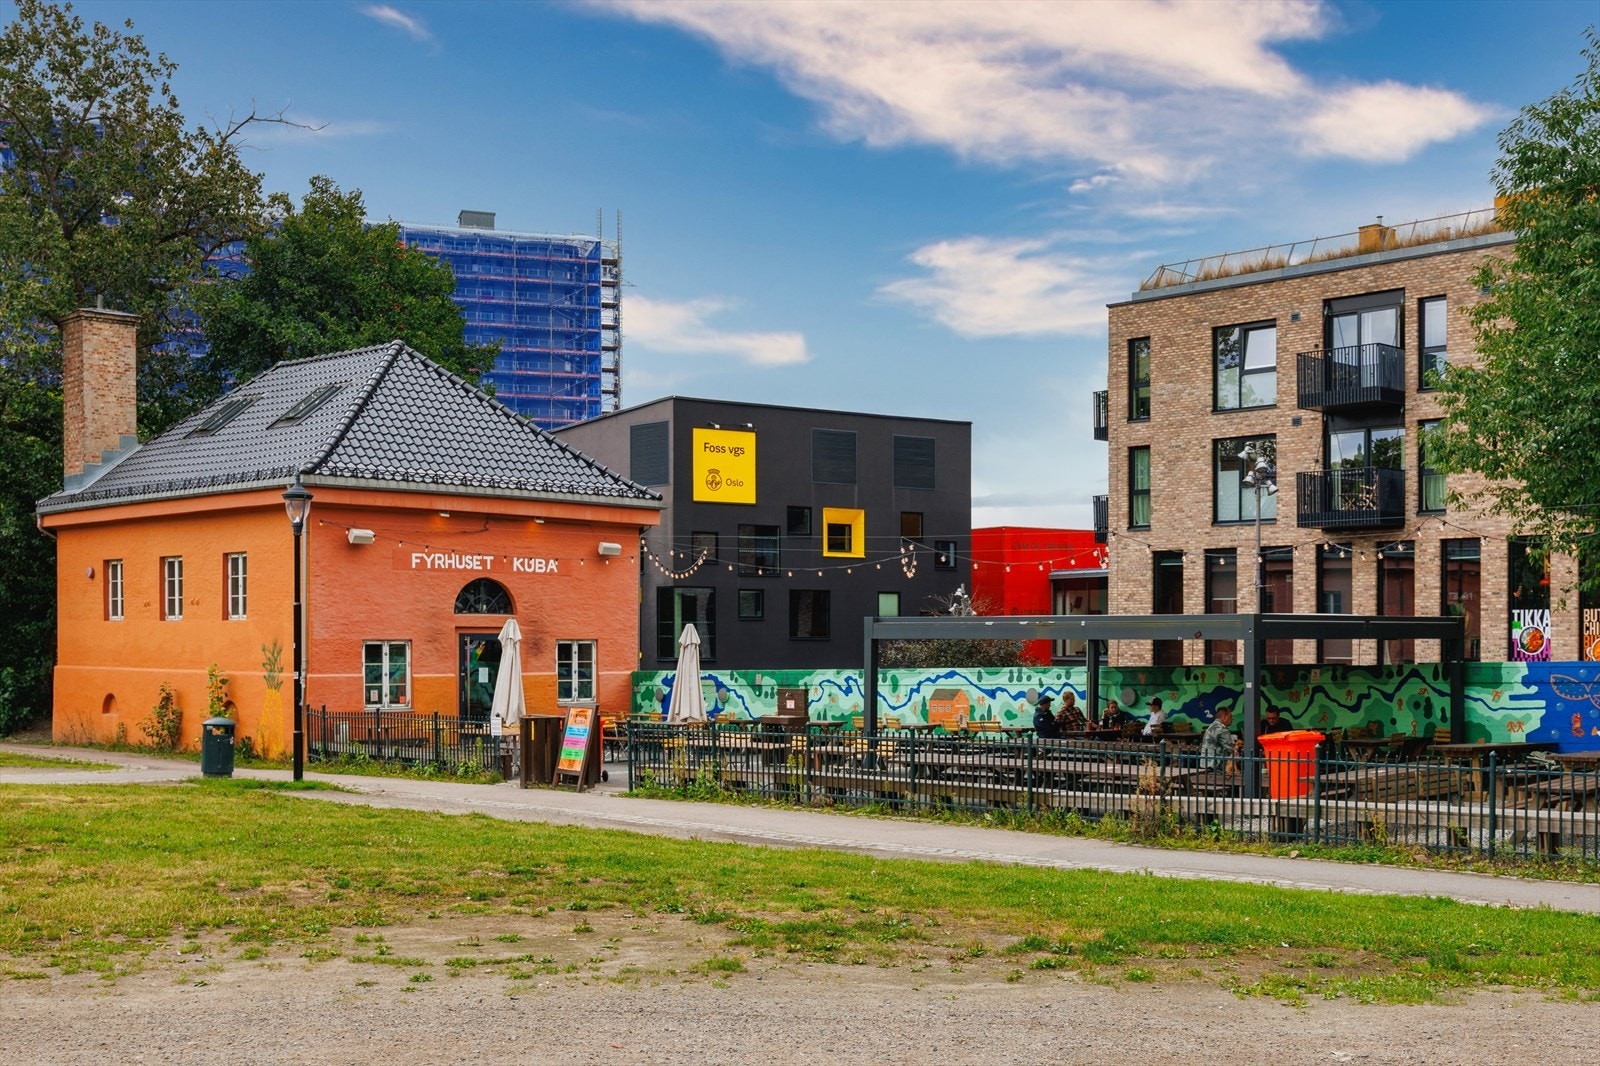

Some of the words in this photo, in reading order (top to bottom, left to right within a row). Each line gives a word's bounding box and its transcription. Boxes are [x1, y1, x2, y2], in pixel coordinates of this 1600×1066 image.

[703, 442, 726, 454] Foss
[728, 446, 745, 457] vgs
[725, 478, 744, 487] Oslo
[411, 552, 494, 570] FYRHUSET
[512, 557, 558, 573] KUBA
[1511, 609, 1551, 628] TIKKA
